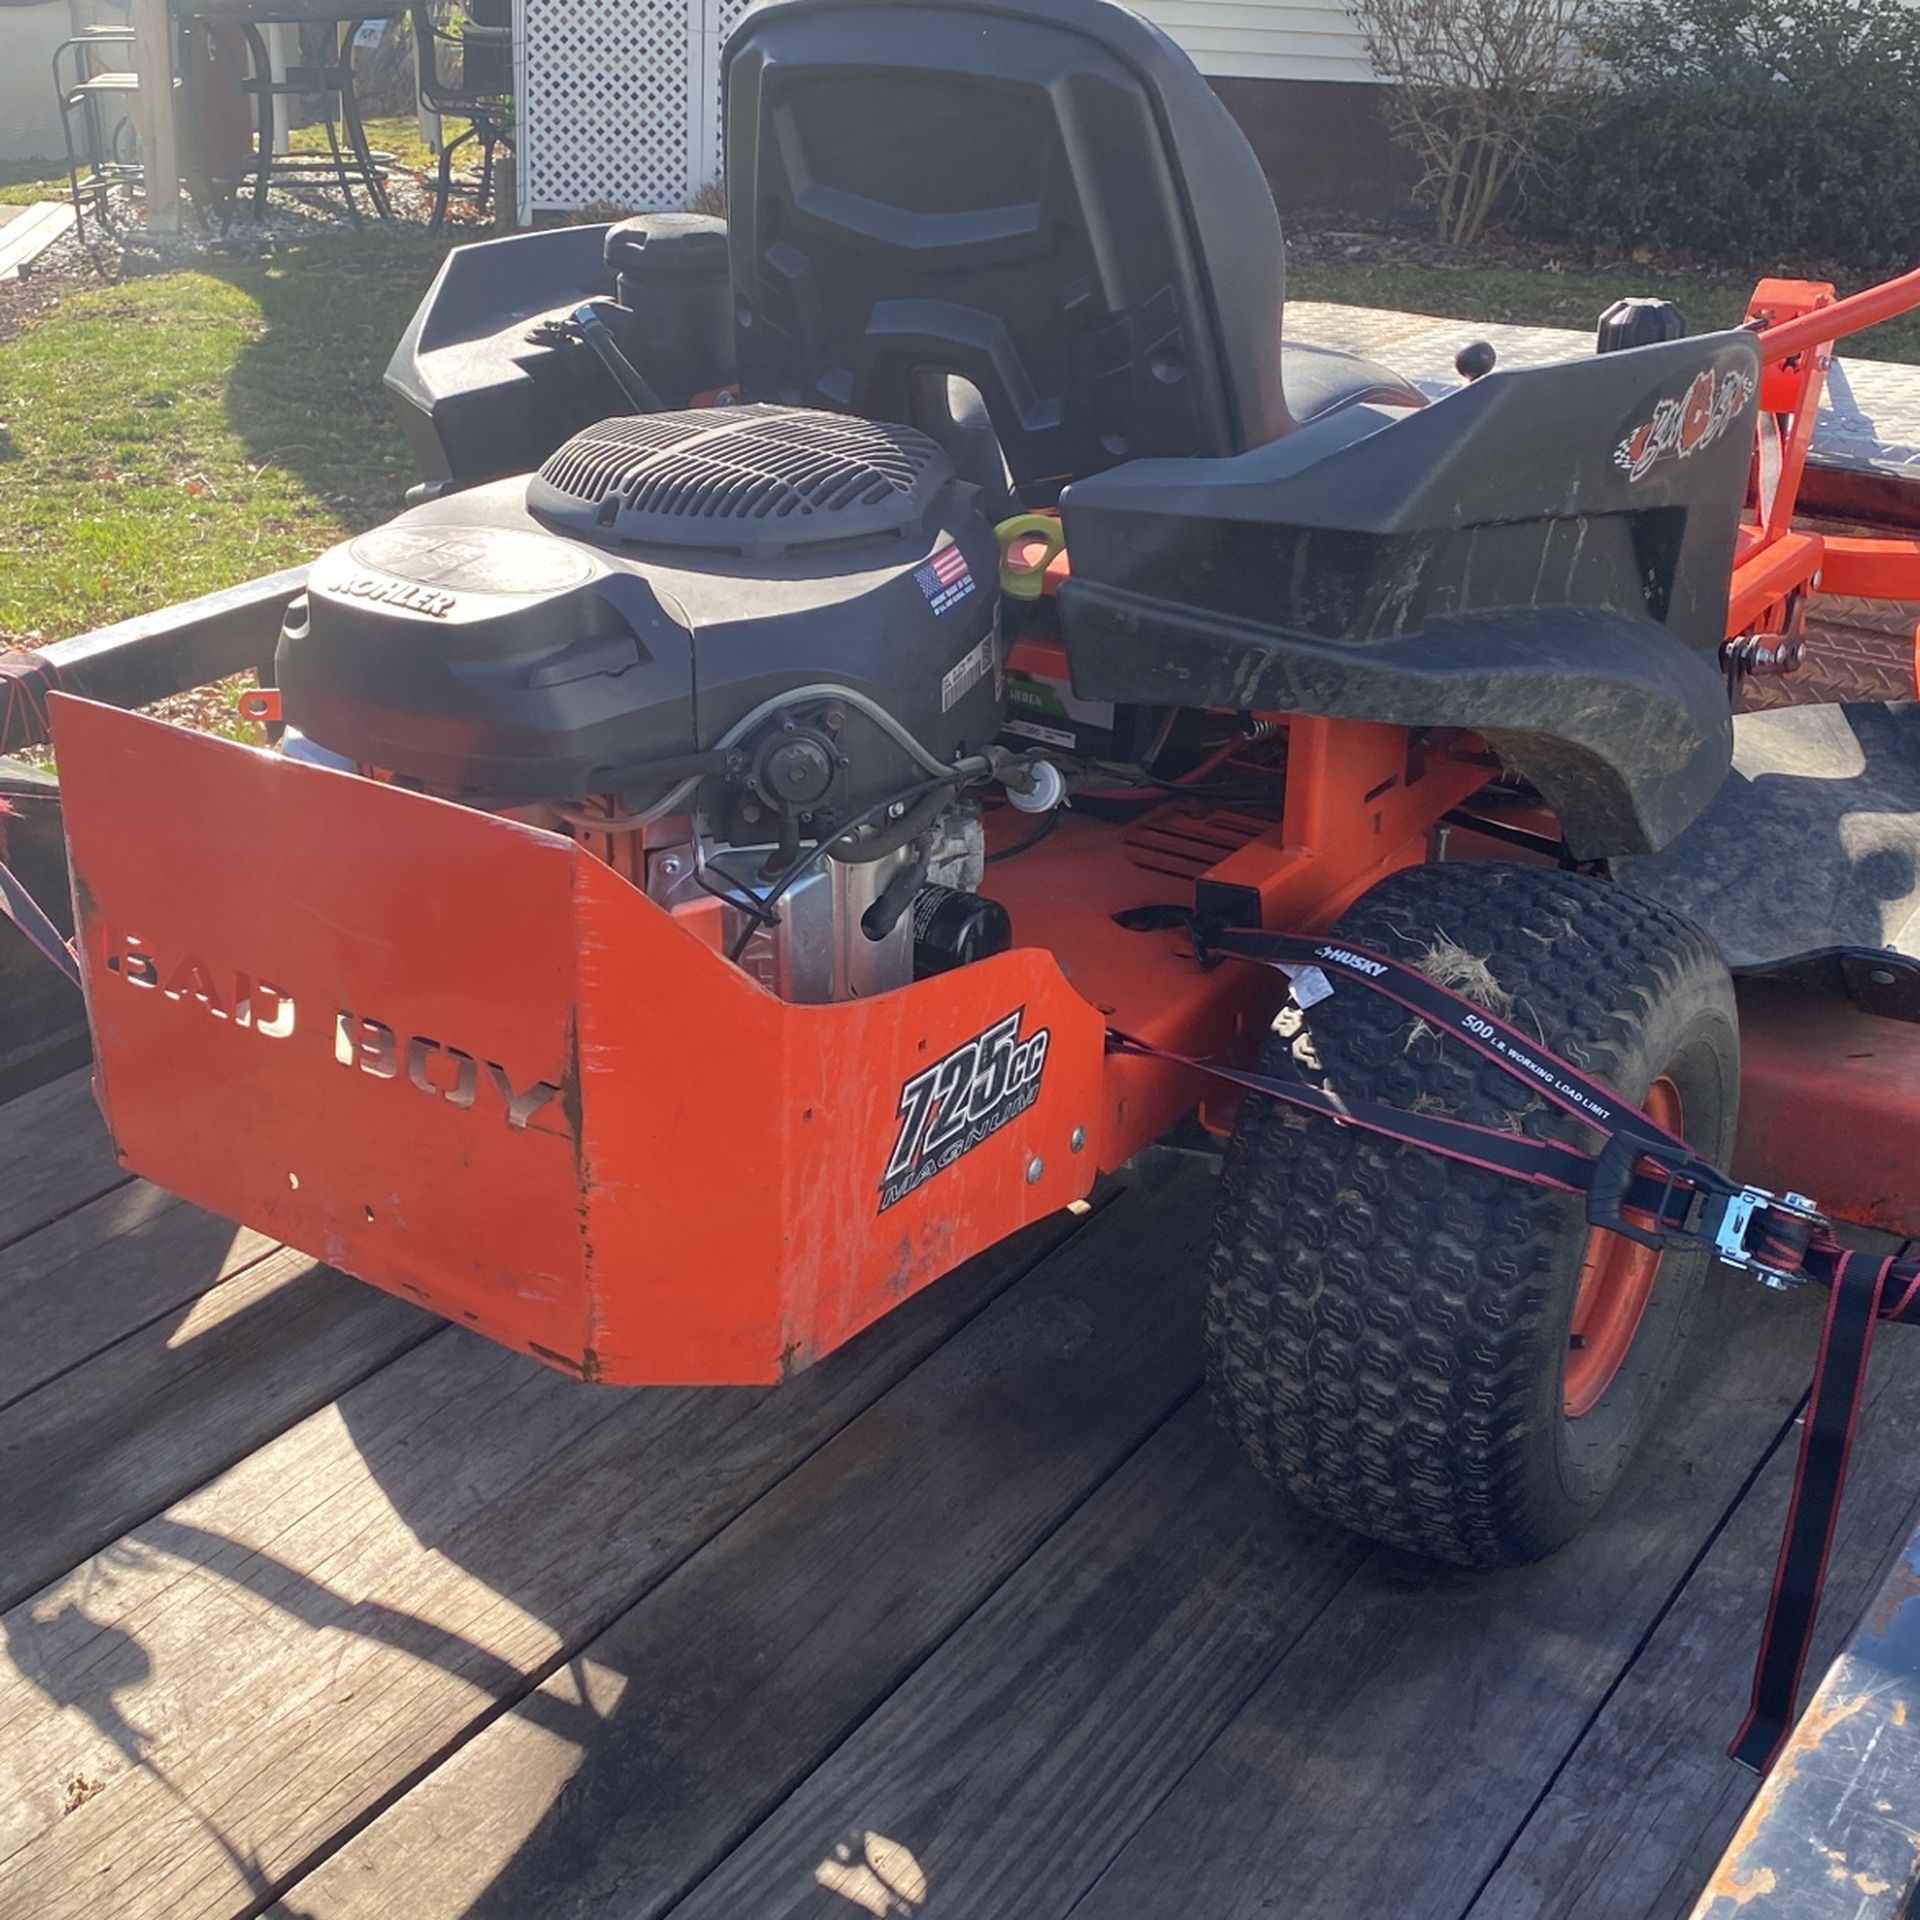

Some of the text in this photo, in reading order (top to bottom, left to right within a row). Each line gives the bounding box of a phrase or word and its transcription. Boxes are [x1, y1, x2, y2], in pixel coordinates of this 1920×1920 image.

[1329, 948, 1389, 977] HUSKY
[104, 923, 562, 1129] BAD BOY
[1461, 1014, 1494, 1039] 500
[1508, 1048, 1554, 1083] WORKING
[1555, 1080, 1584, 1102] LOAD
[1582, 1097, 1611, 1120] LIMIT
[880, 1083, 1040, 1210] MAGNUM
